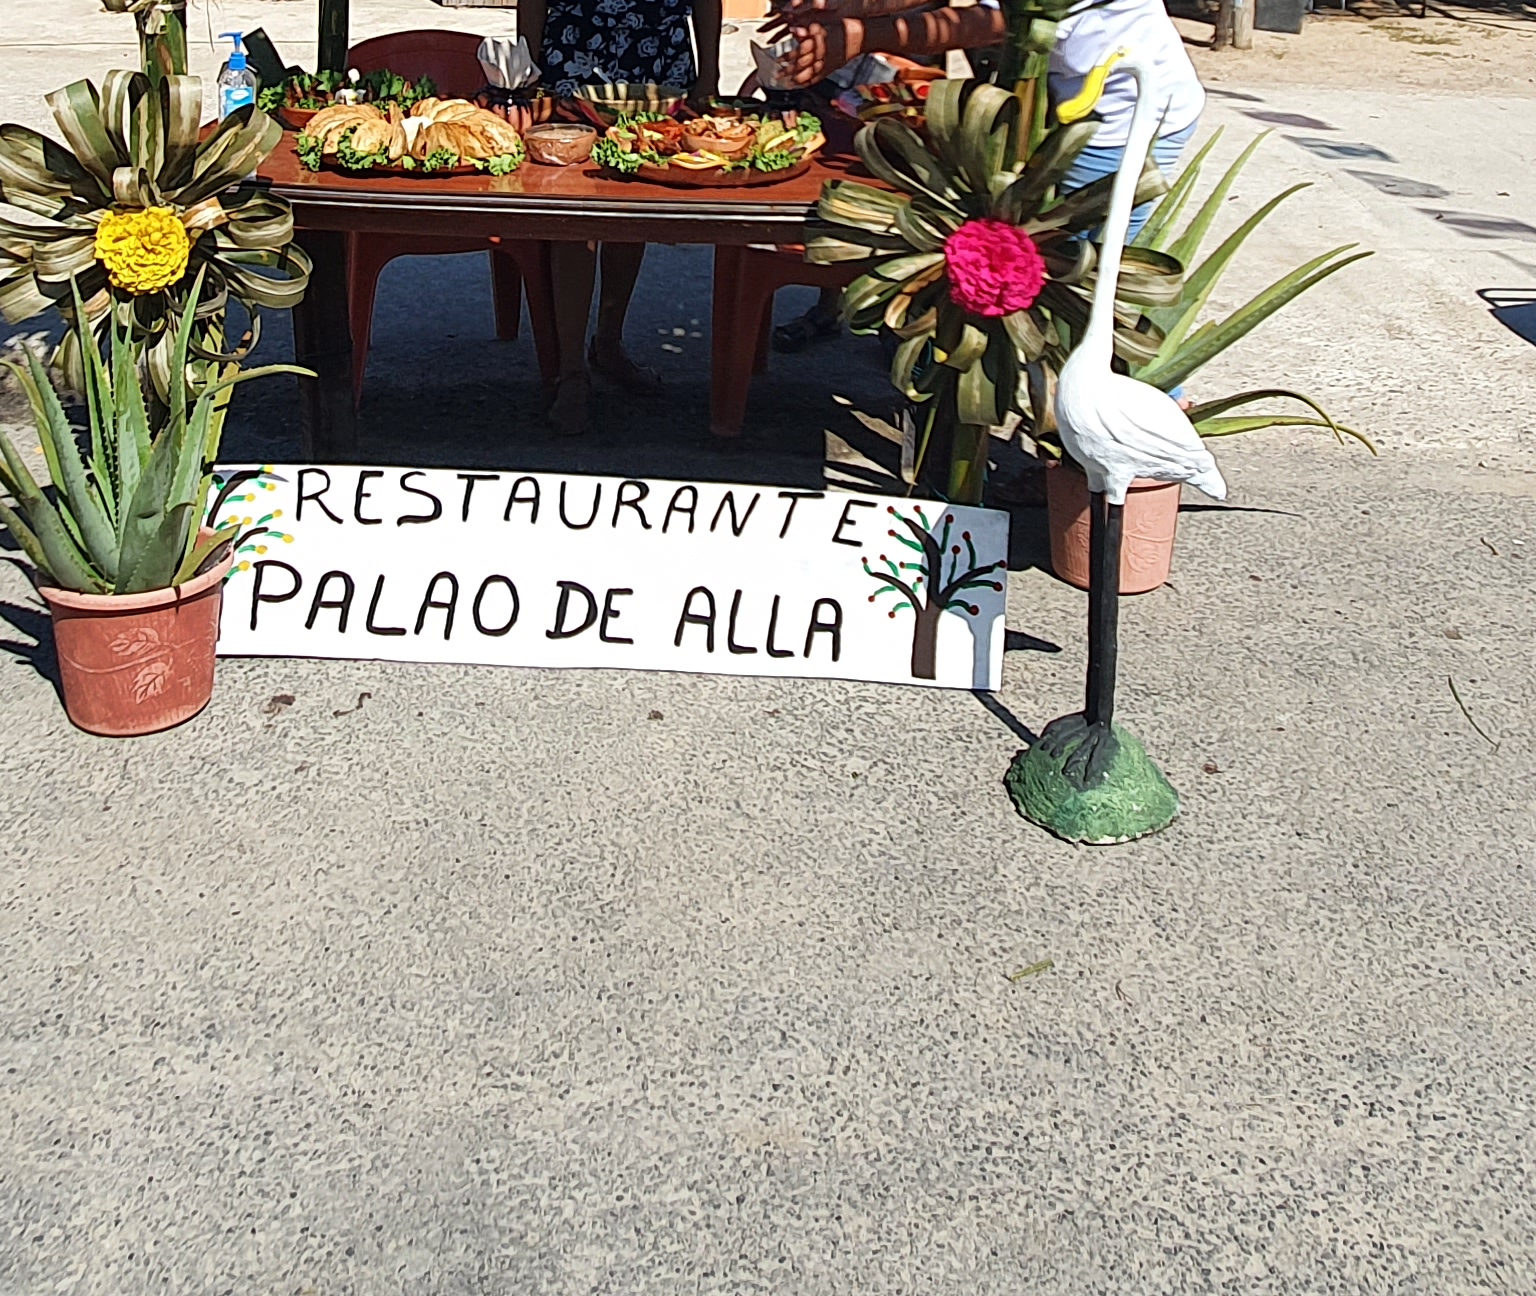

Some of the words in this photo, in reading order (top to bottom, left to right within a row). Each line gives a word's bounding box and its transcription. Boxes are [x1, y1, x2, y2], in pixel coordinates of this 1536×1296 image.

[295, 467, 879, 548] RESTAURANTE
[249, 559, 521, 641] PALAO
[545, 580, 635, 645] DE
[673, 586, 844, 662] ALLA
